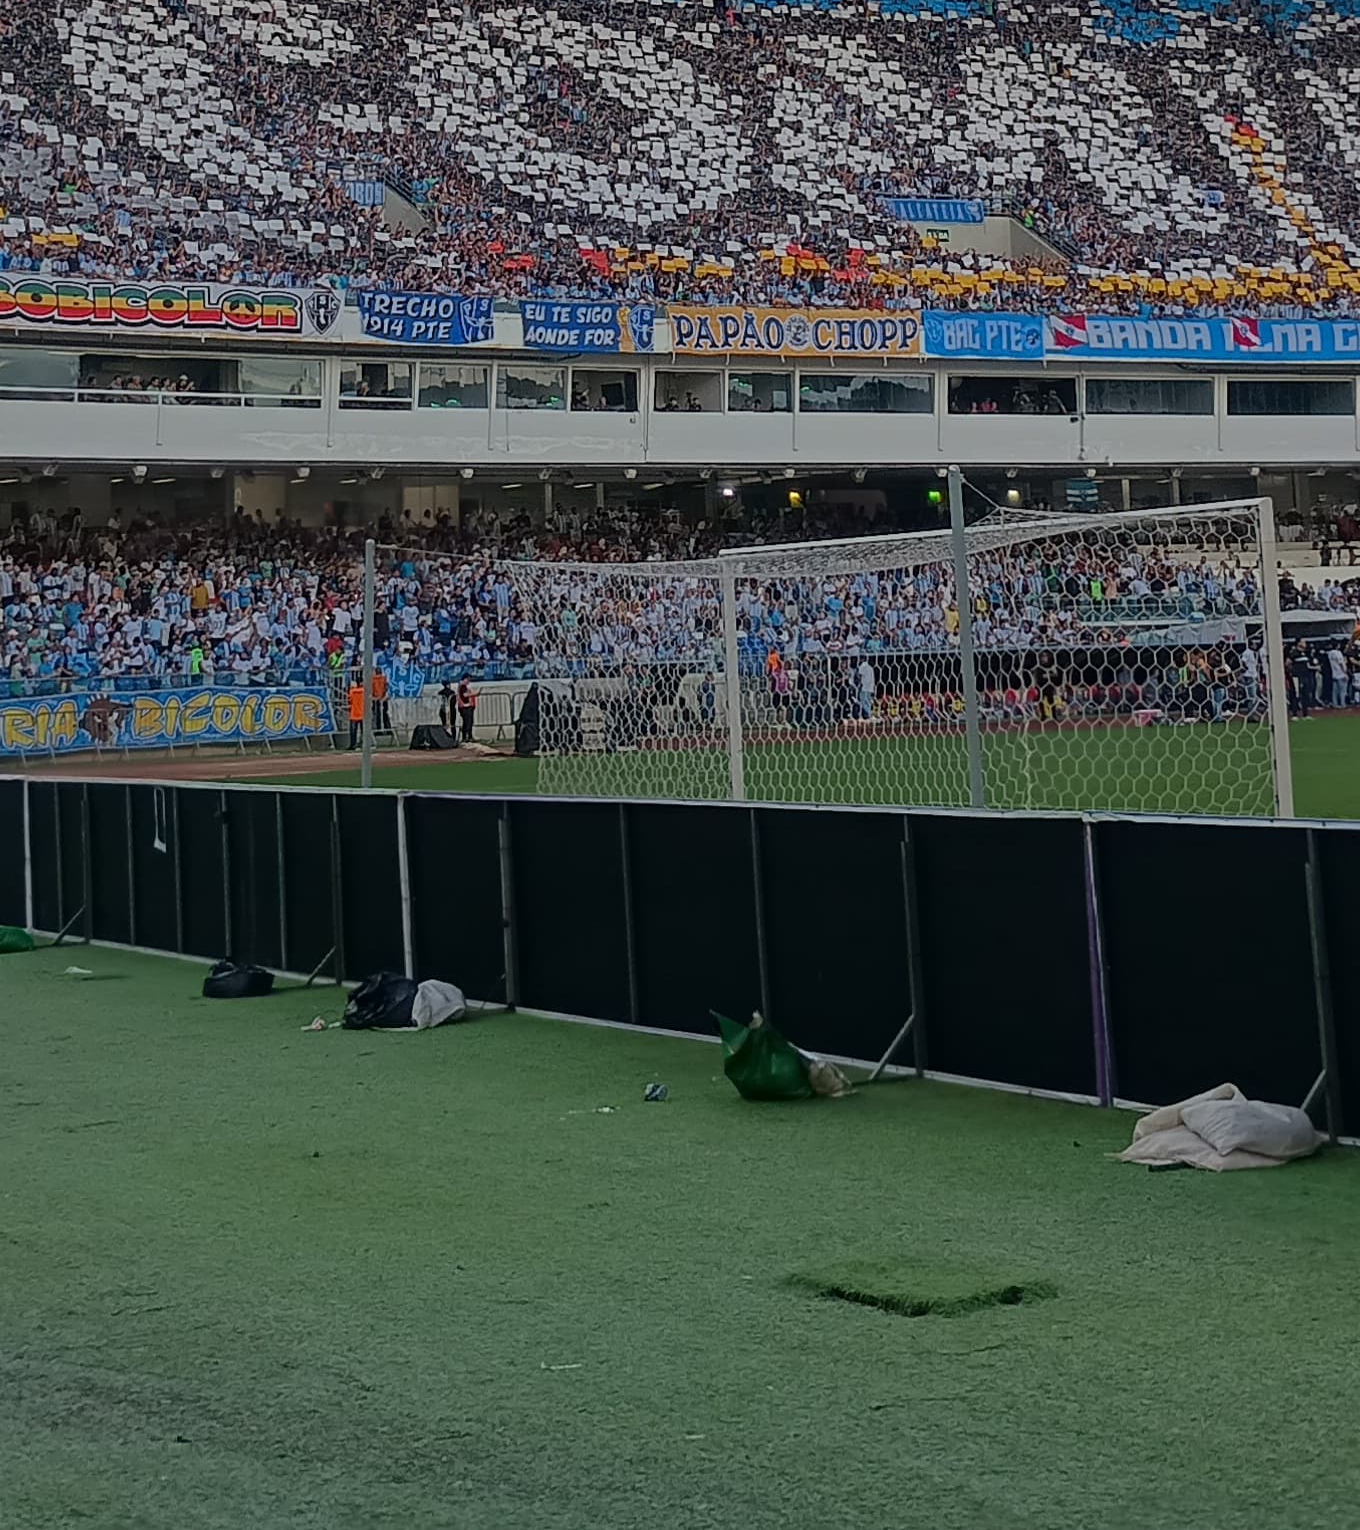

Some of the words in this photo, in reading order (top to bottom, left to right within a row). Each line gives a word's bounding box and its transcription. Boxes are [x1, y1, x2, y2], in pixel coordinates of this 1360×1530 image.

[361, 292, 455, 319] TRECHO
[524, 303, 546, 321] EU
[551, 304, 571, 323] TE
[576, 305, 613, 324] SIGO
[362, 312, 404, 337] 1914
[411, 320, 453, 339] PTE
[524, 327, 580, 346] AONDE
[584, 328, 617, 346] FOR
[672, 310, 786, 351] PAPÃO
[811, 316, 919, 352] CHOPP
[985, 320, 1024, 352] PTE
[1090, 321, 1213, 351] BANDA
[132, 692, 328, 739] BICOLOR
